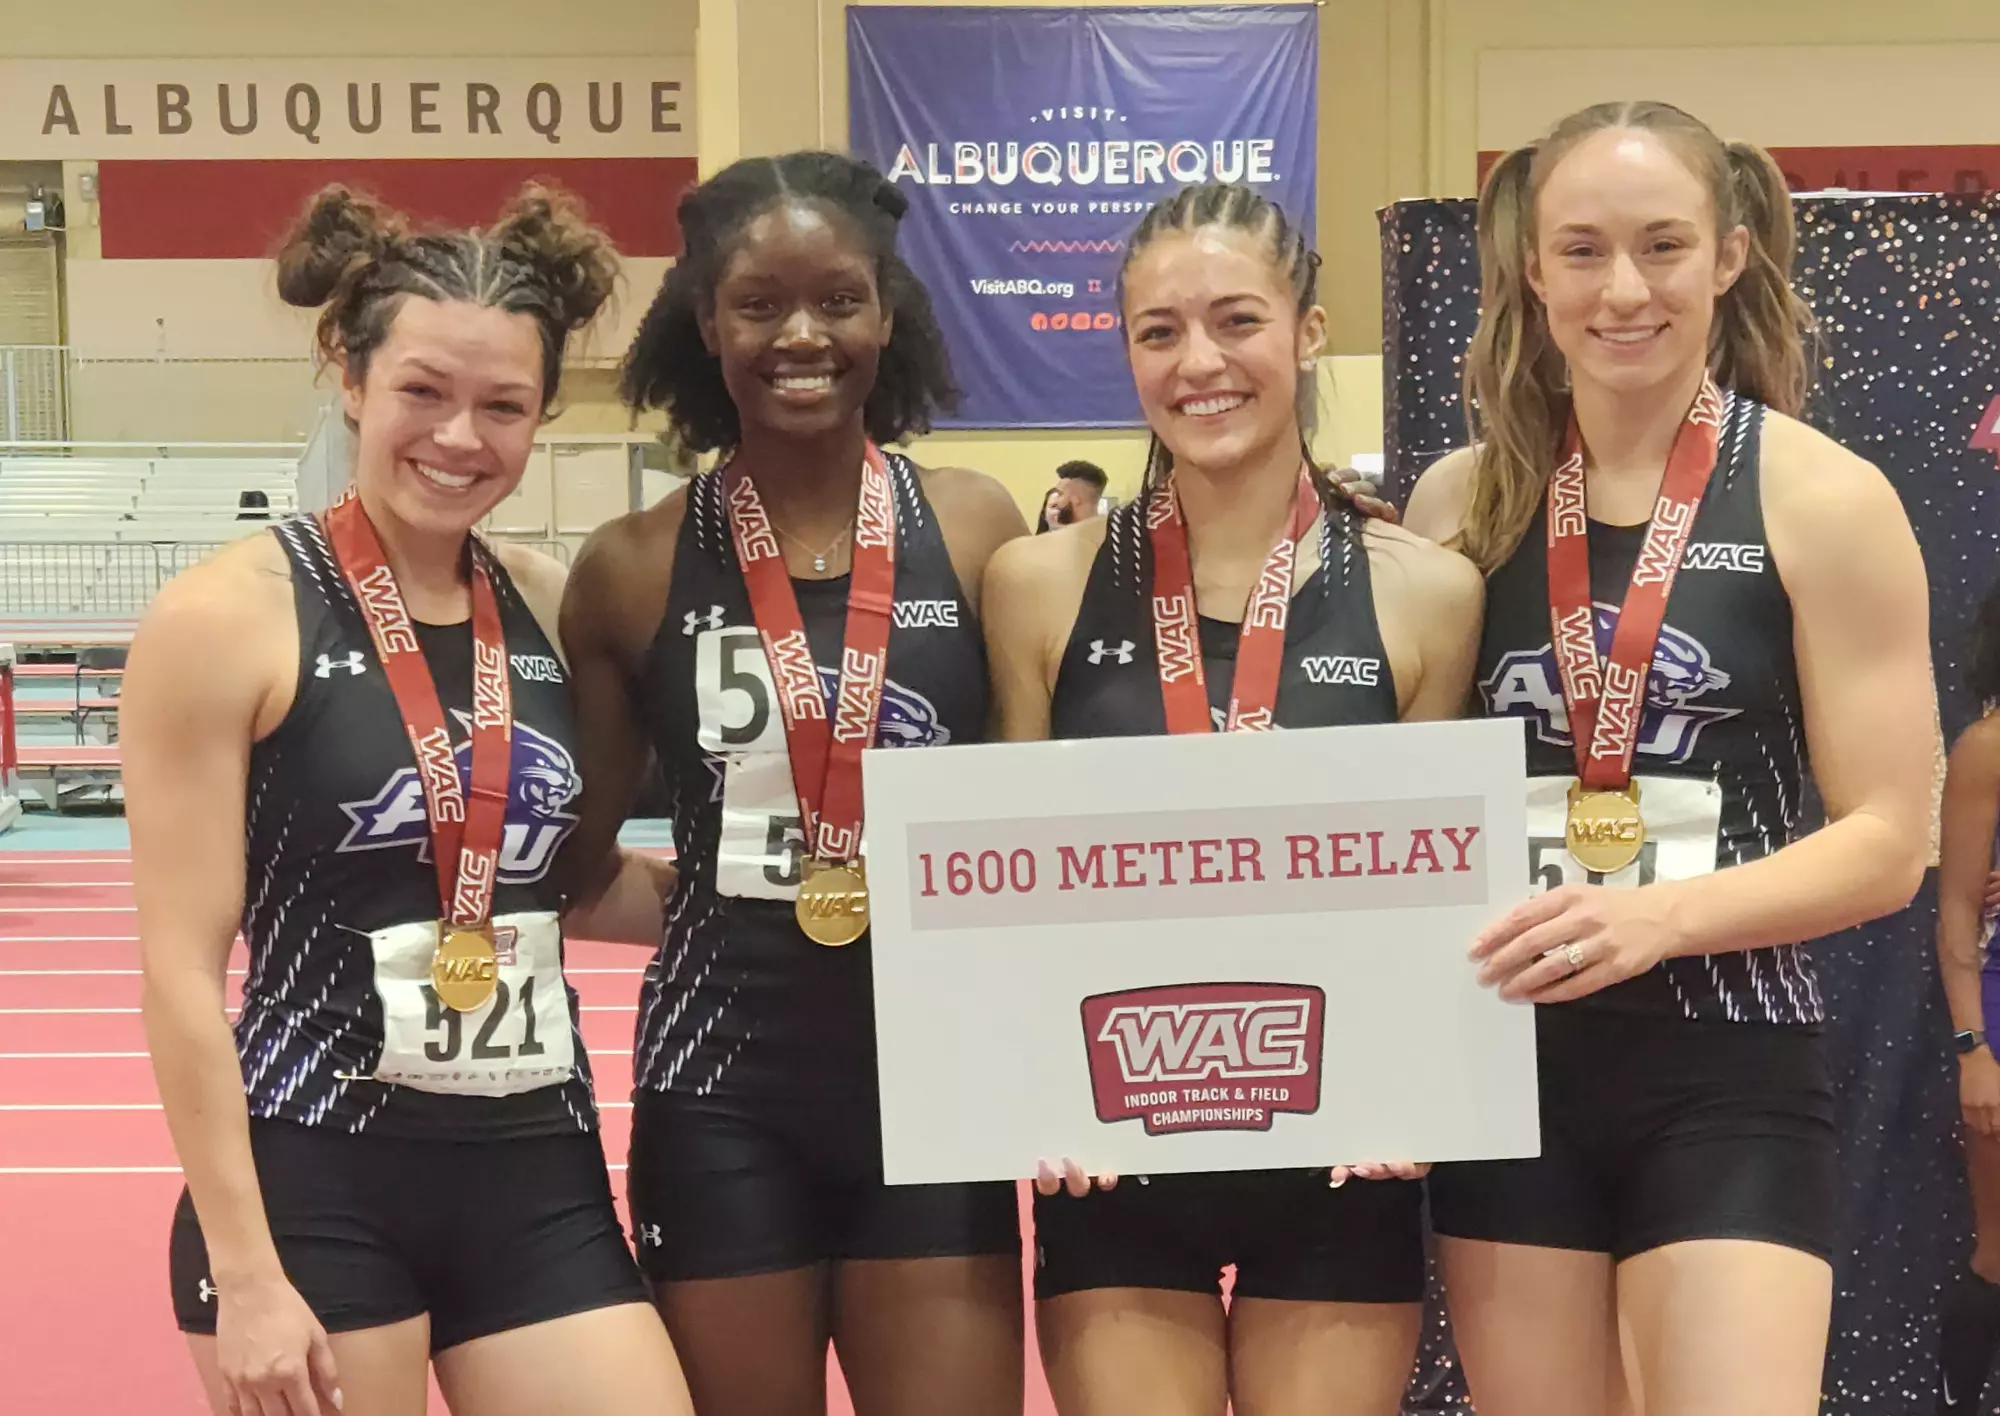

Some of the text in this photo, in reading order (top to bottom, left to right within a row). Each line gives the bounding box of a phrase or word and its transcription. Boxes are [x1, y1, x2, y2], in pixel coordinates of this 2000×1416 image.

[42, 81, 682, 144] ALBUQUERQUE
[949, 202, 1022, 214] CHANGE
[1032, 202, 1079, 214] YOUR
[970, 279, 1074, 298] VisitABQ.org
[730, 476, 779, 561] WAC
[856, 462, 883, 549] WAC
[1555, 453, 1586, 537] WAC
[1633, 496, 1690, 587] WAC
[1682, 543, 1764, 573] WAC
[359, 565, 419, 653] WAC
[892, 601, 959, 628] WAC
[1253, 539, 1295, 630] WAC
[510, 655, 563, 684] WAC
[774, 630, 826, 719] WAC
[1153, 596, 1194, 683] WAC
[1301, 656, 1380, 687] WAC
[1560, 606, 1602, 700] WAC
[473, 638, 505, 730] WAC
[833, 648, 878, 744] WAC
[1591, 662, 1639, 760] WAC
[421, 727, 464, 823] WAC
[918, 827, 1480, 897] 1600 METER RELAY
[419, 976, 546, 1062] 521
[1104, 1002, 1308, 1080] WAC
[1124, 1087, 1289, 1108] INDOOR TRACK & FIELD
[1152, 1107, 1264, 1126] CHAMPIONSHIPS
